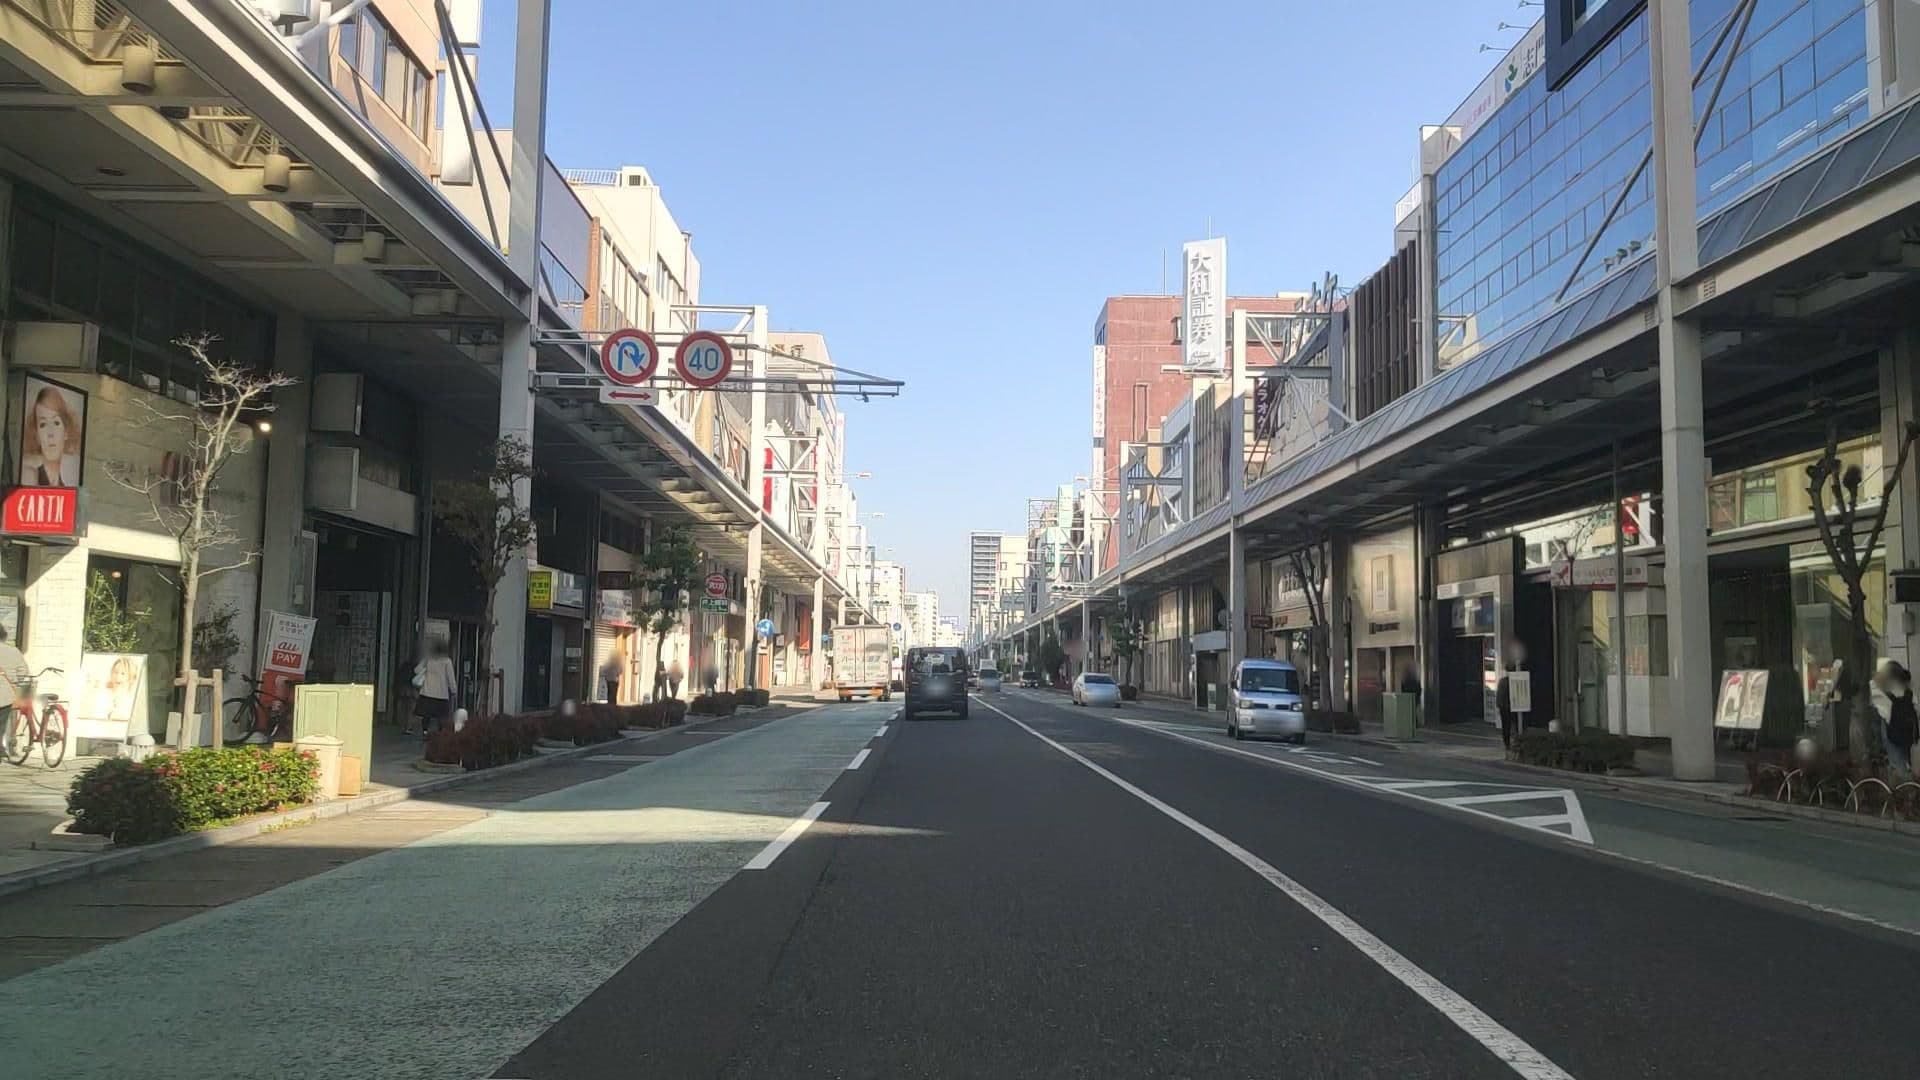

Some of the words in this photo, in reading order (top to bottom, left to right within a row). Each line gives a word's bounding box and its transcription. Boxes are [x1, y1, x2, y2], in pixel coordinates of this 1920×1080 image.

[1190, 252, 1213, 345] 大和証券
[688, 347, 719, 371] 40
[17, 494, 65, 523] EARTH
[276, 652, 297, 664] PAY
[278, 641, 298, 651] au
